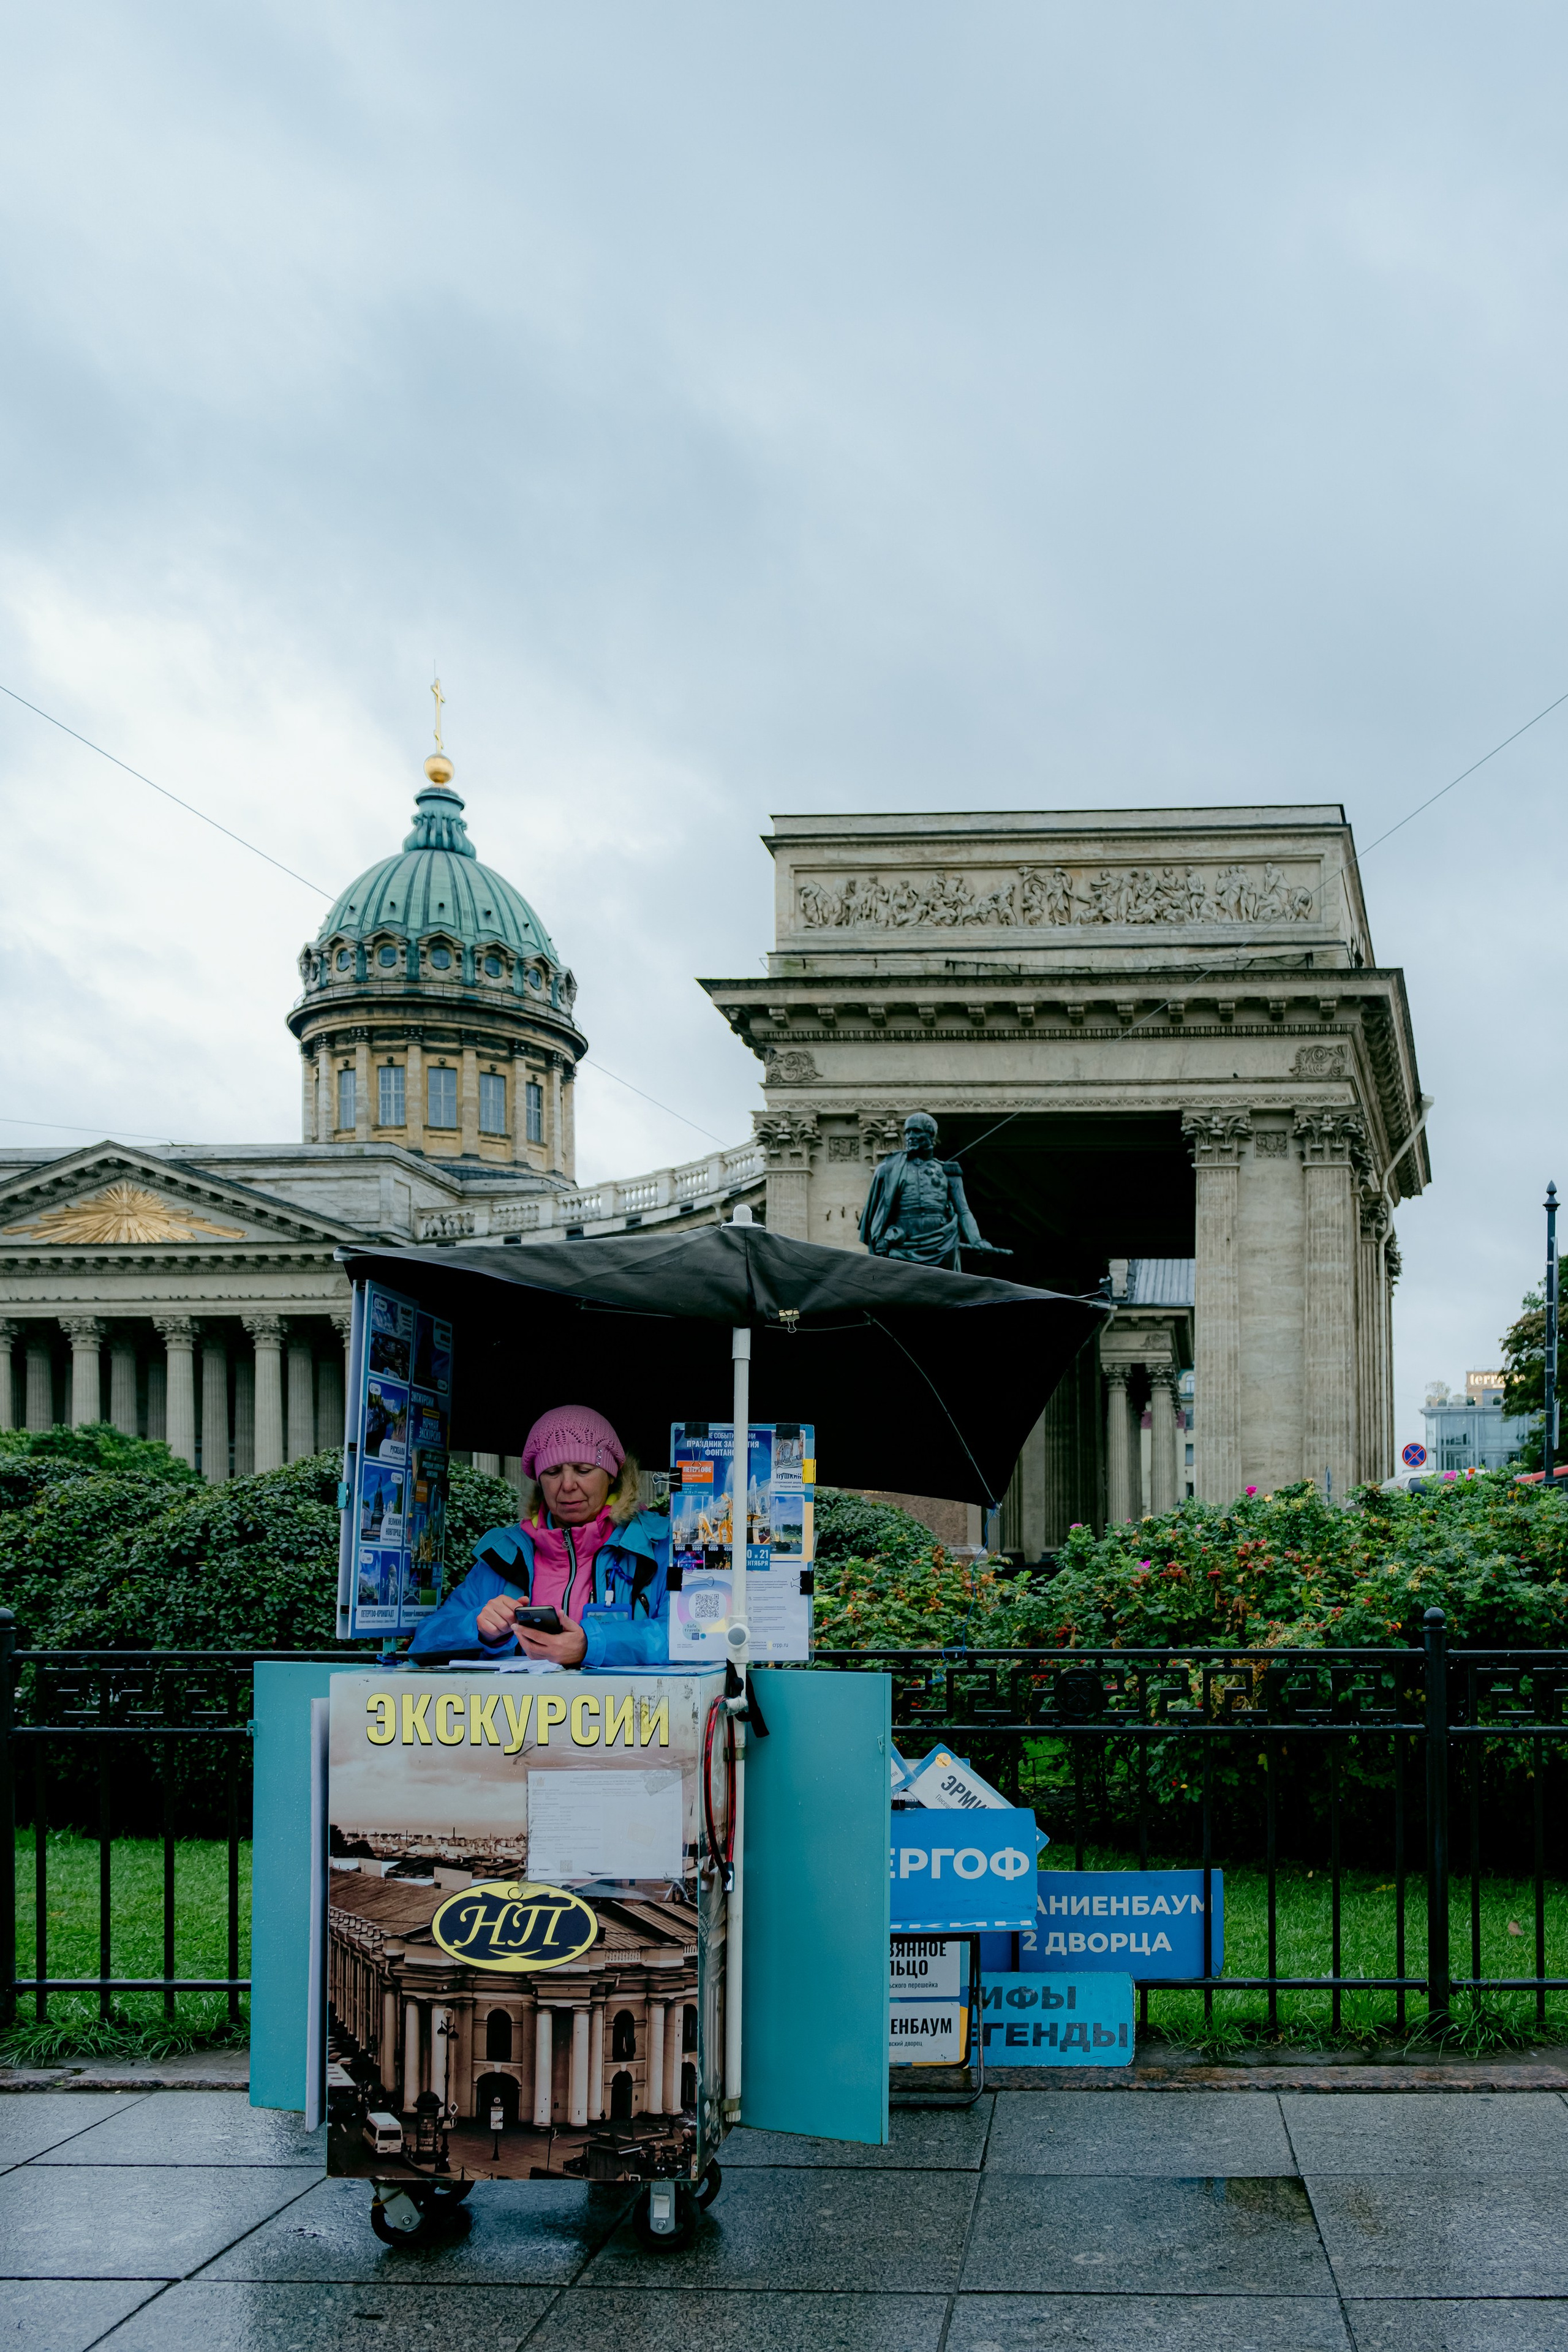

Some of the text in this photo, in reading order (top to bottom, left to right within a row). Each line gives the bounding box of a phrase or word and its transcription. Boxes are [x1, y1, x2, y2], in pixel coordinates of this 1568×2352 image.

[760, 1549, 769, 1559] 21
[366, 1692, 669, 1755] ЭКСКУРСИИ
[941, 1775, 989, 1809] ЭРМИ
[1022, 1931, 1172, 1955] 2 ДВОРЦА
